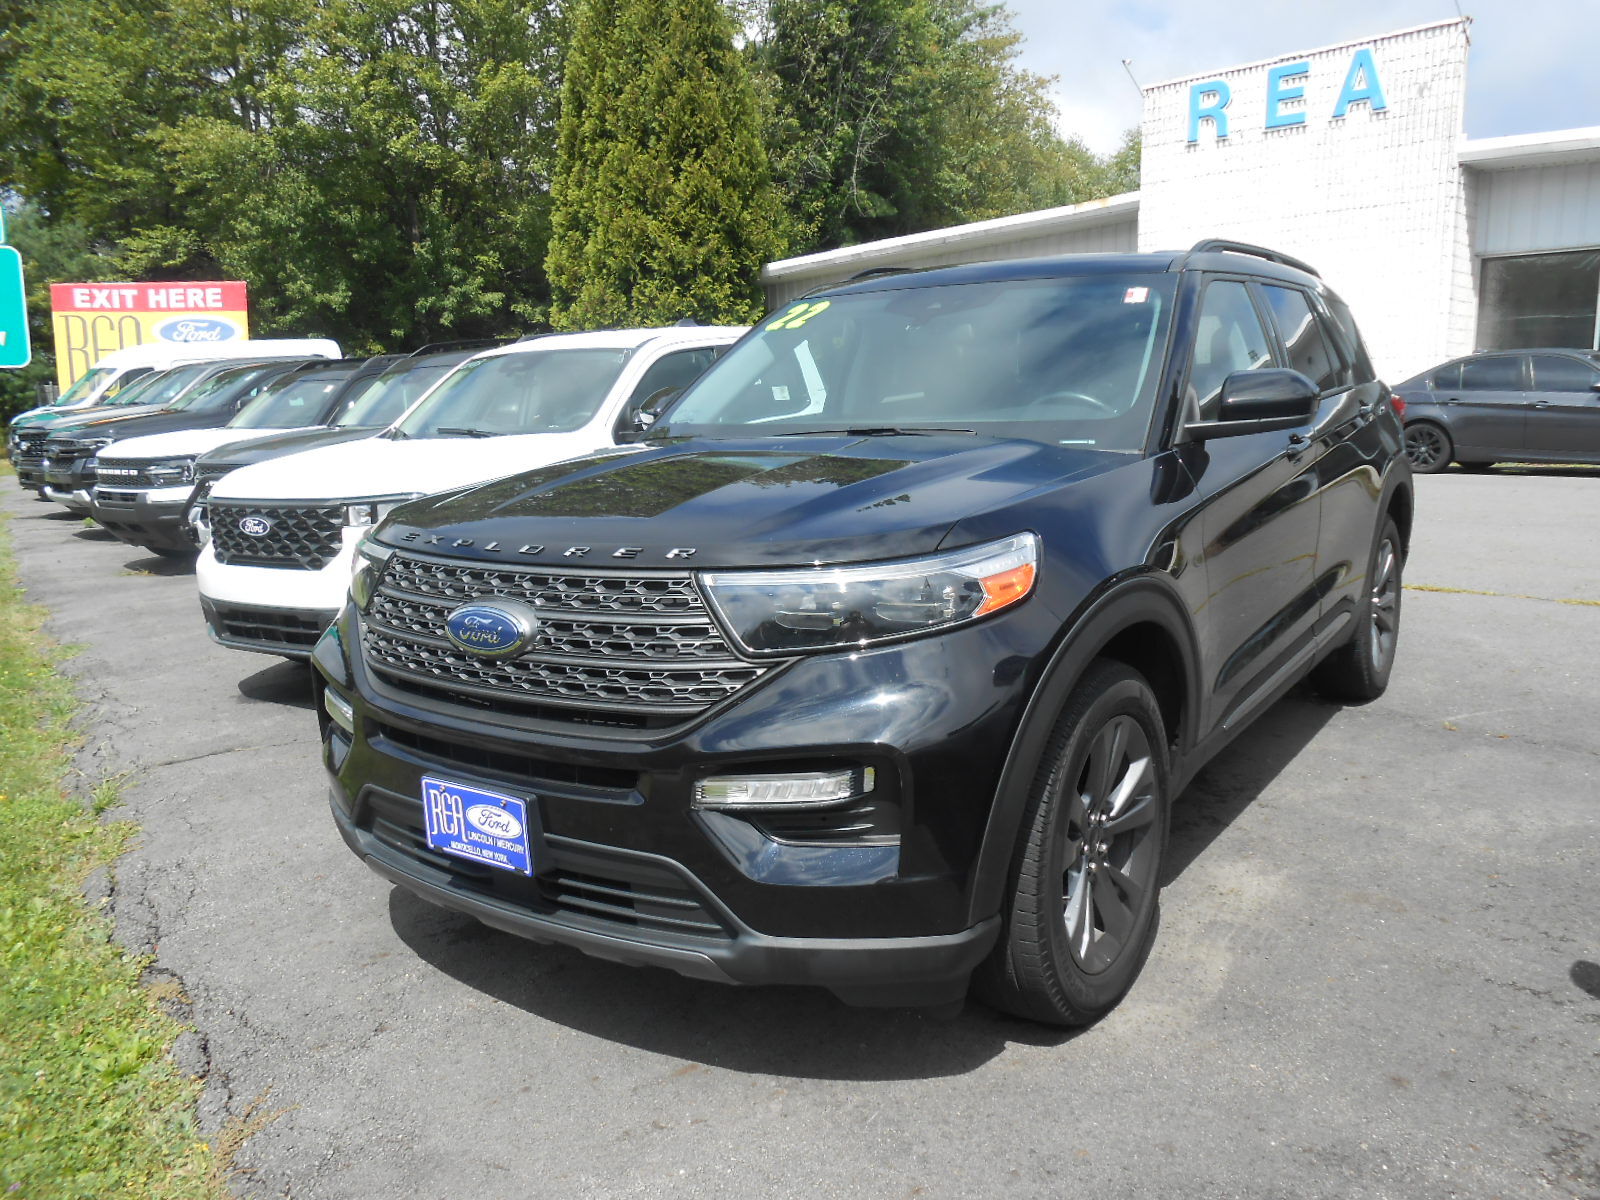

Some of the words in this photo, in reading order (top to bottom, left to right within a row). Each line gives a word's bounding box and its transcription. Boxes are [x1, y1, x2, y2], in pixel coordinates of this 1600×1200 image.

[1186, 47, 1388, 144] REA
[72, 288, 139, 309] EXIT
[148, 287, 223, 308] HERE
[764, 300, 832, 332] 22
[172, 320, 222, 341] Ford
[244, 519, 264, 533] Ford
[400, 532, 697, 560] EXPLORER
[459, 615, 503, 644] Ford
[428, 788, 468, 843] REA
[479, 809, 511, 833] Ford
